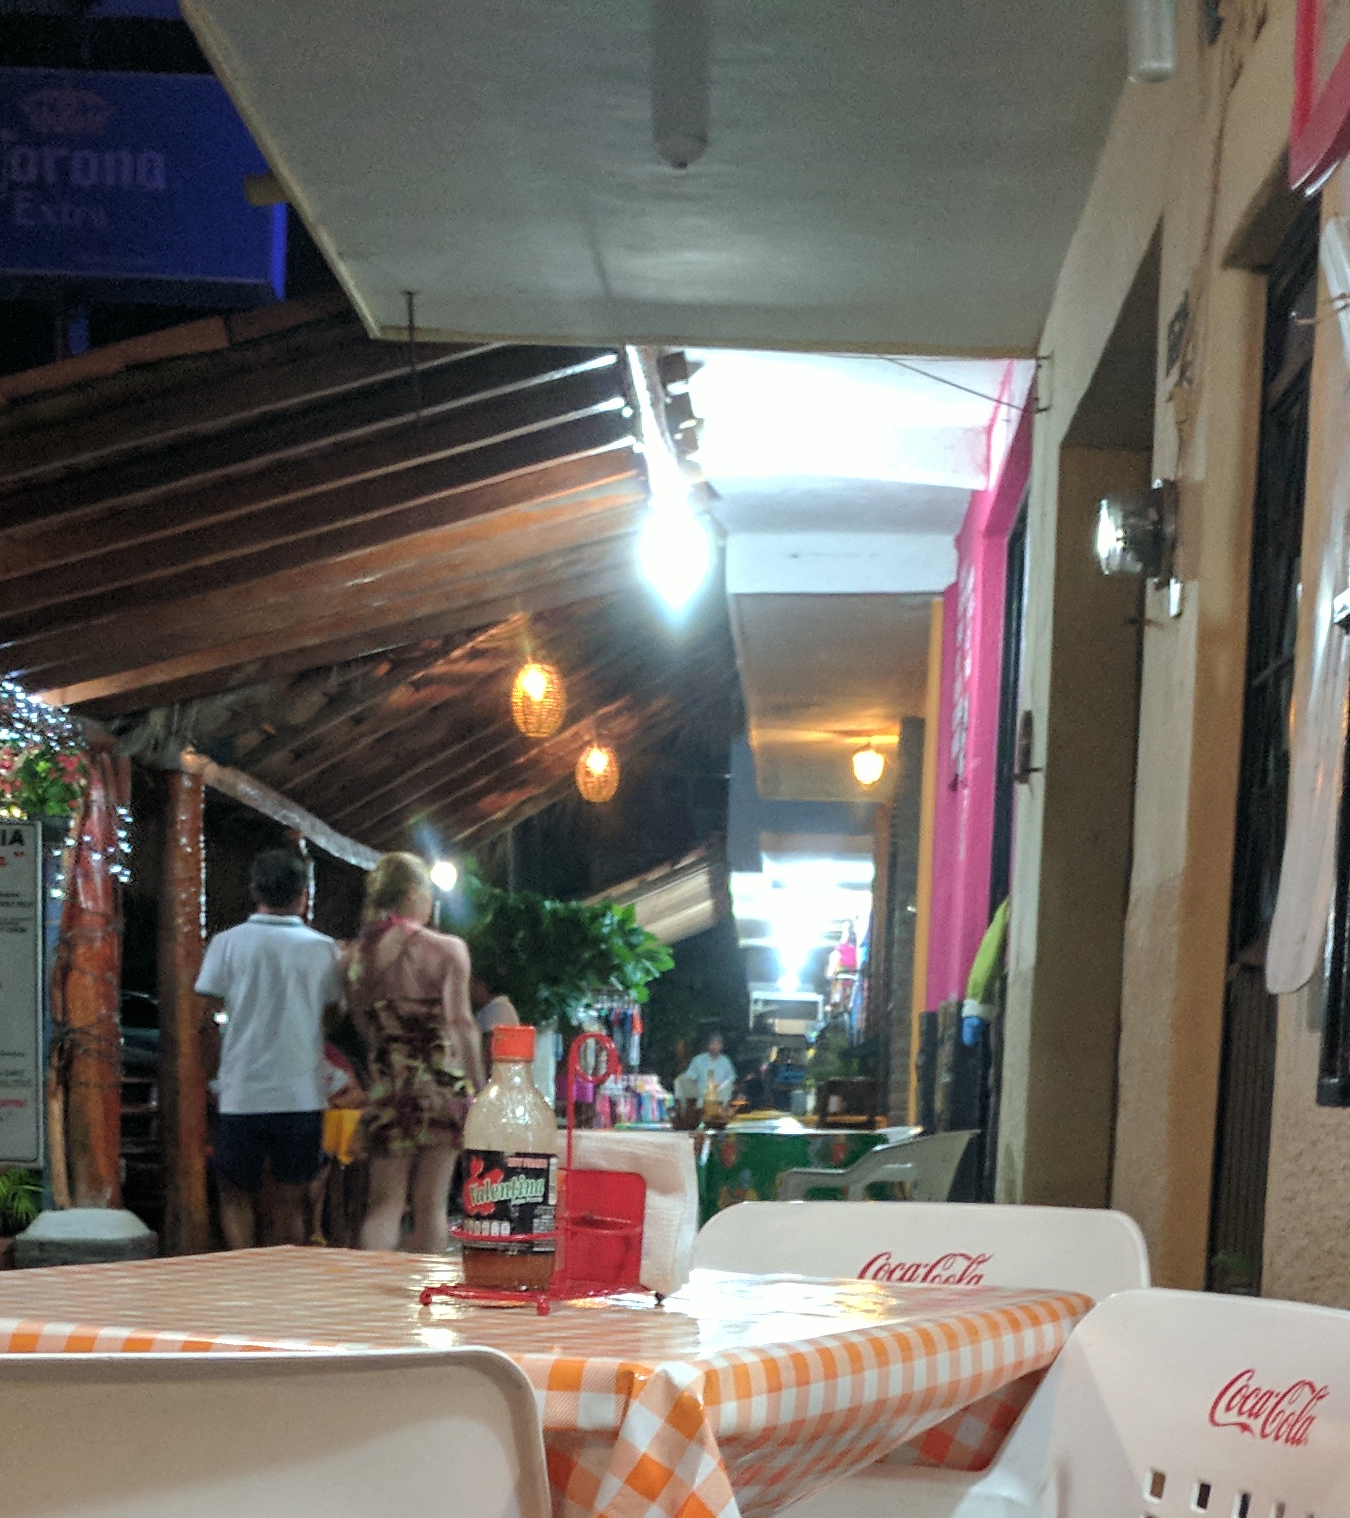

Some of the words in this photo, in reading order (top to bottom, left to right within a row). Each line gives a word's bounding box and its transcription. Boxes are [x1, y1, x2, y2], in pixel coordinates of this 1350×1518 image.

[13, 197, 108, 229] Extra
[468, 1174, 545, 1206] Valentina
[1208, 1367, 1330, 1447] Coca-Cola
